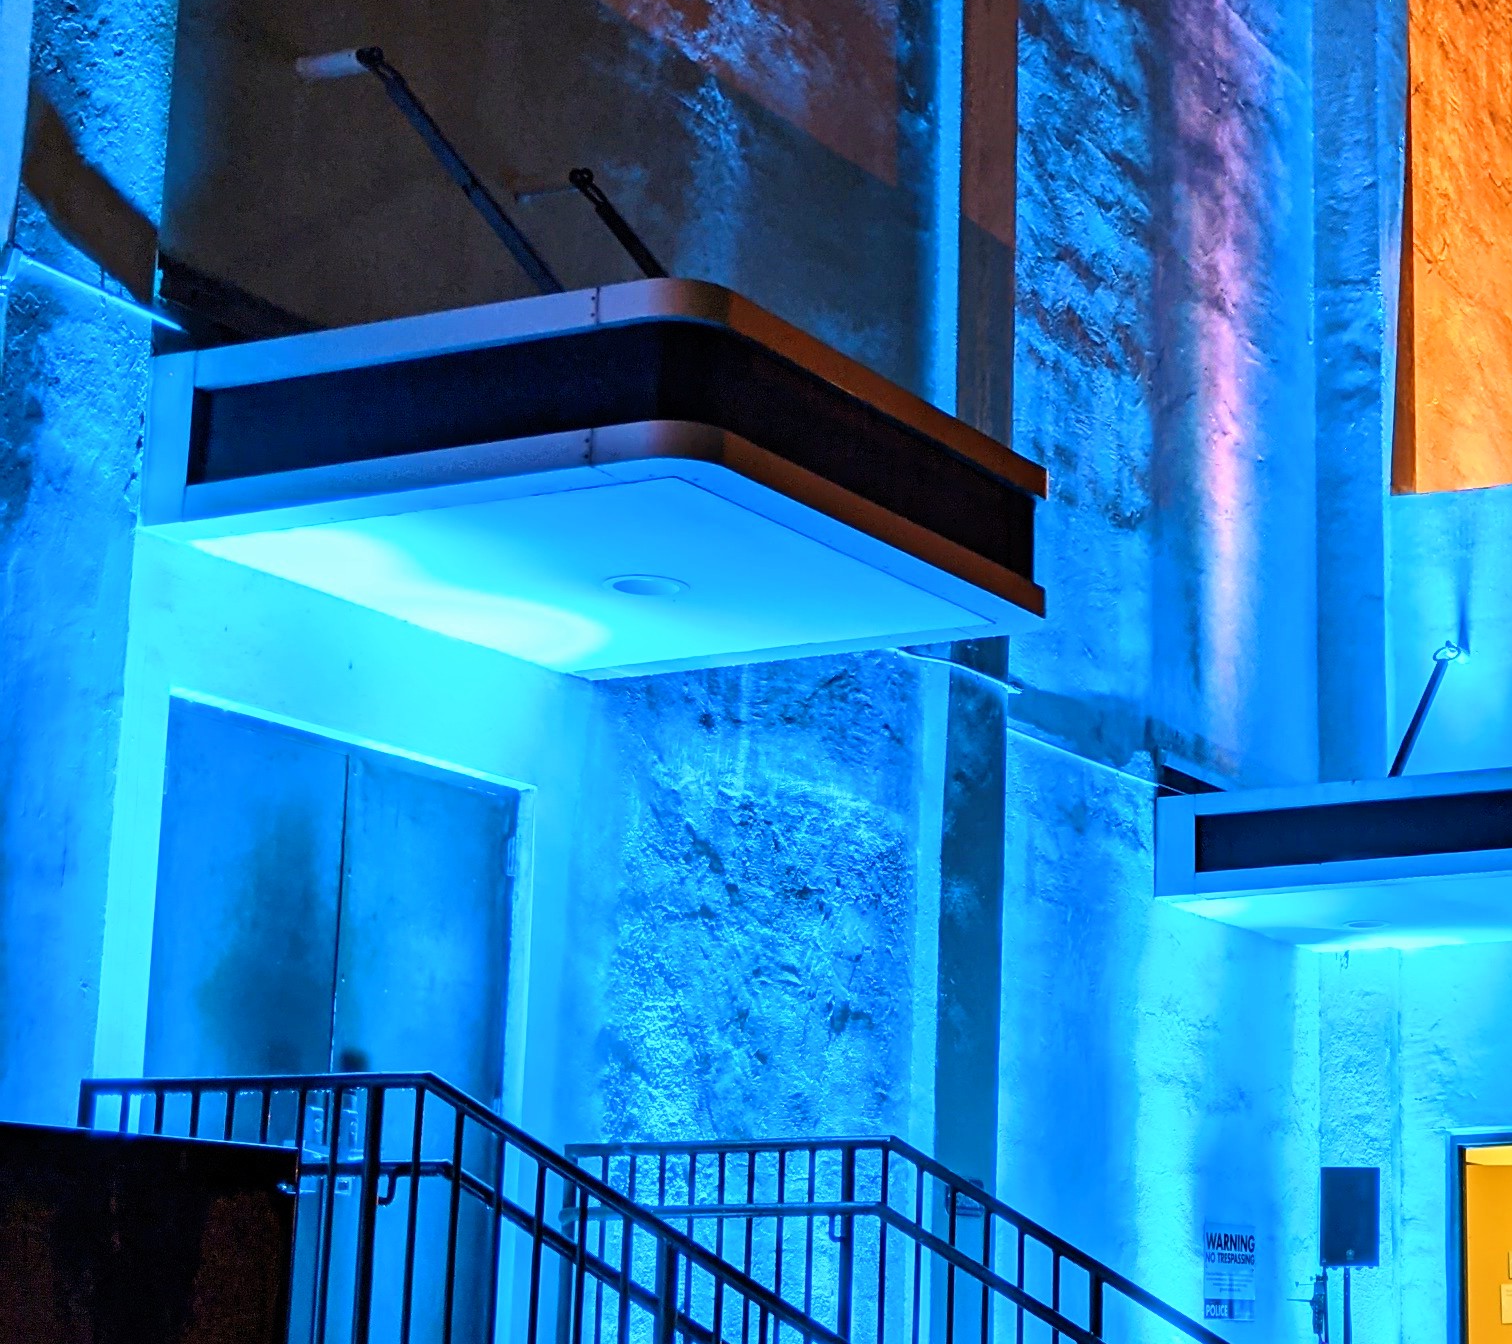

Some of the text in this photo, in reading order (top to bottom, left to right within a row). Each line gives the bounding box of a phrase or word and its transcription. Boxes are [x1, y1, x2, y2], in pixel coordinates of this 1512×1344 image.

[1206, 1232, 1255, 1253] WARNING
[1206, 1253, 1255, 1265] NO TRESPASSING
[1205, 1304, 1228, 1317] POLICE
